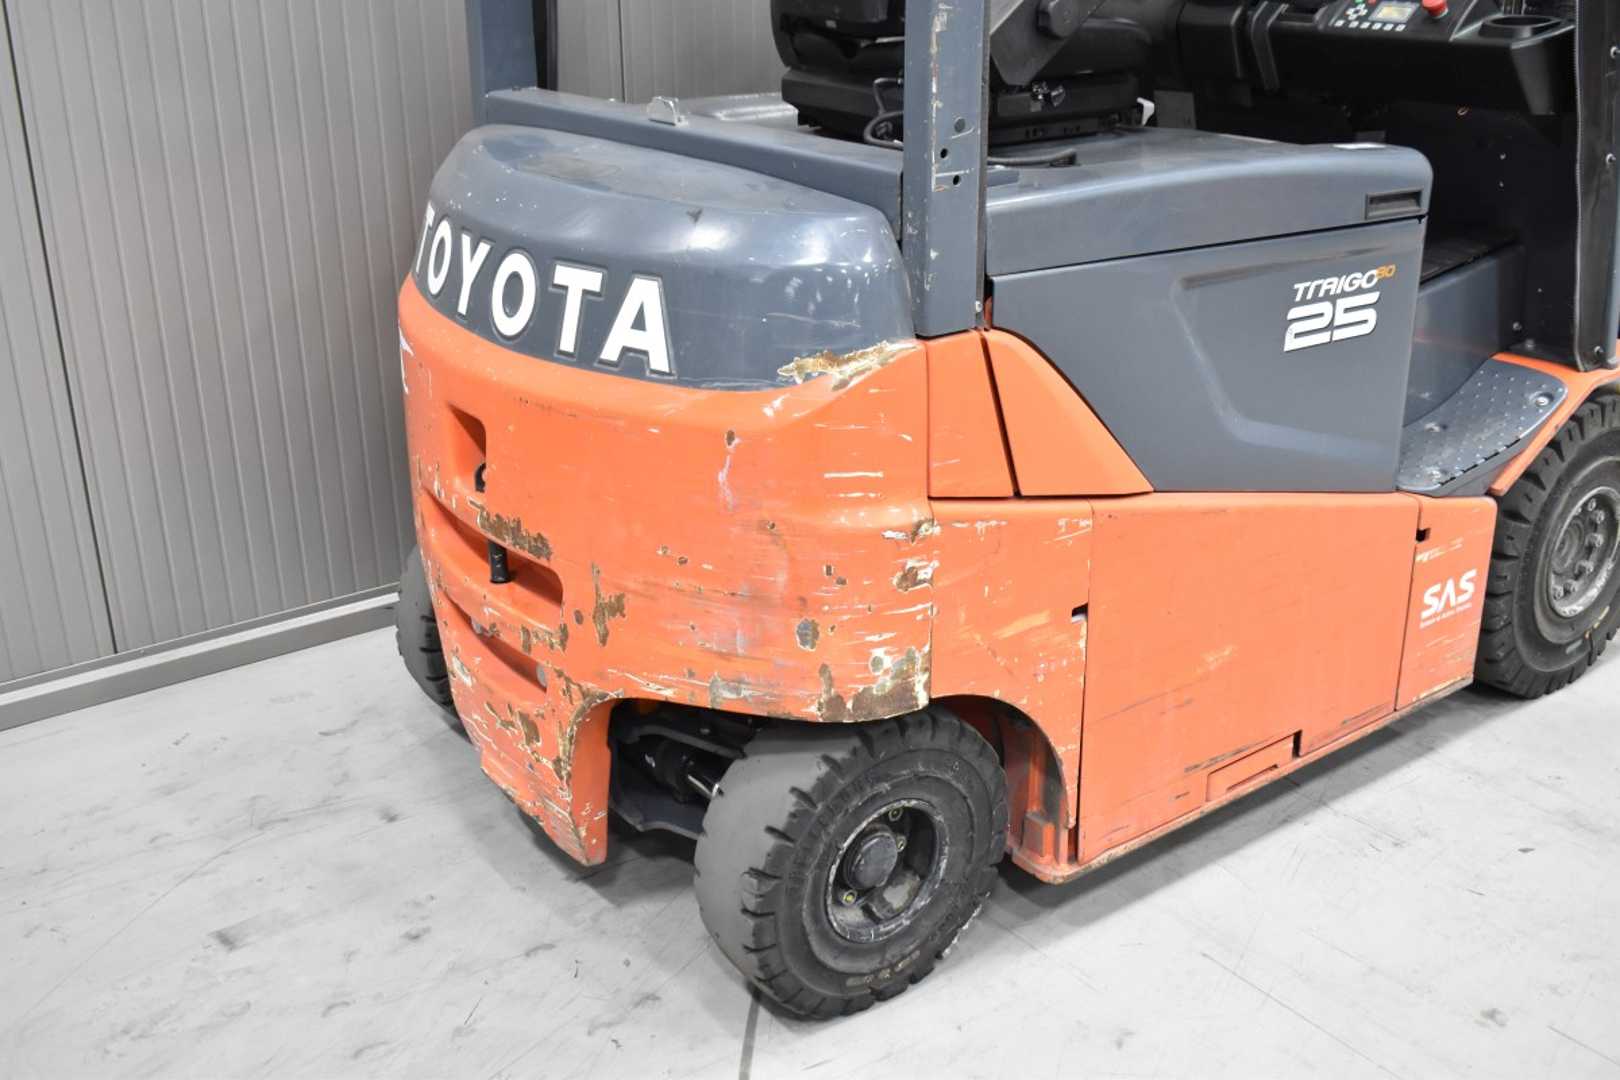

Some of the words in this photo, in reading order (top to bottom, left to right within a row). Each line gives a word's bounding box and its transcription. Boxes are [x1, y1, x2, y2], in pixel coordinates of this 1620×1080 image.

[415, 201, 671, 375] TOYOTA
[1284, 291, 1381, 352] 25
[1420, 568, 1477, 620] SAS
